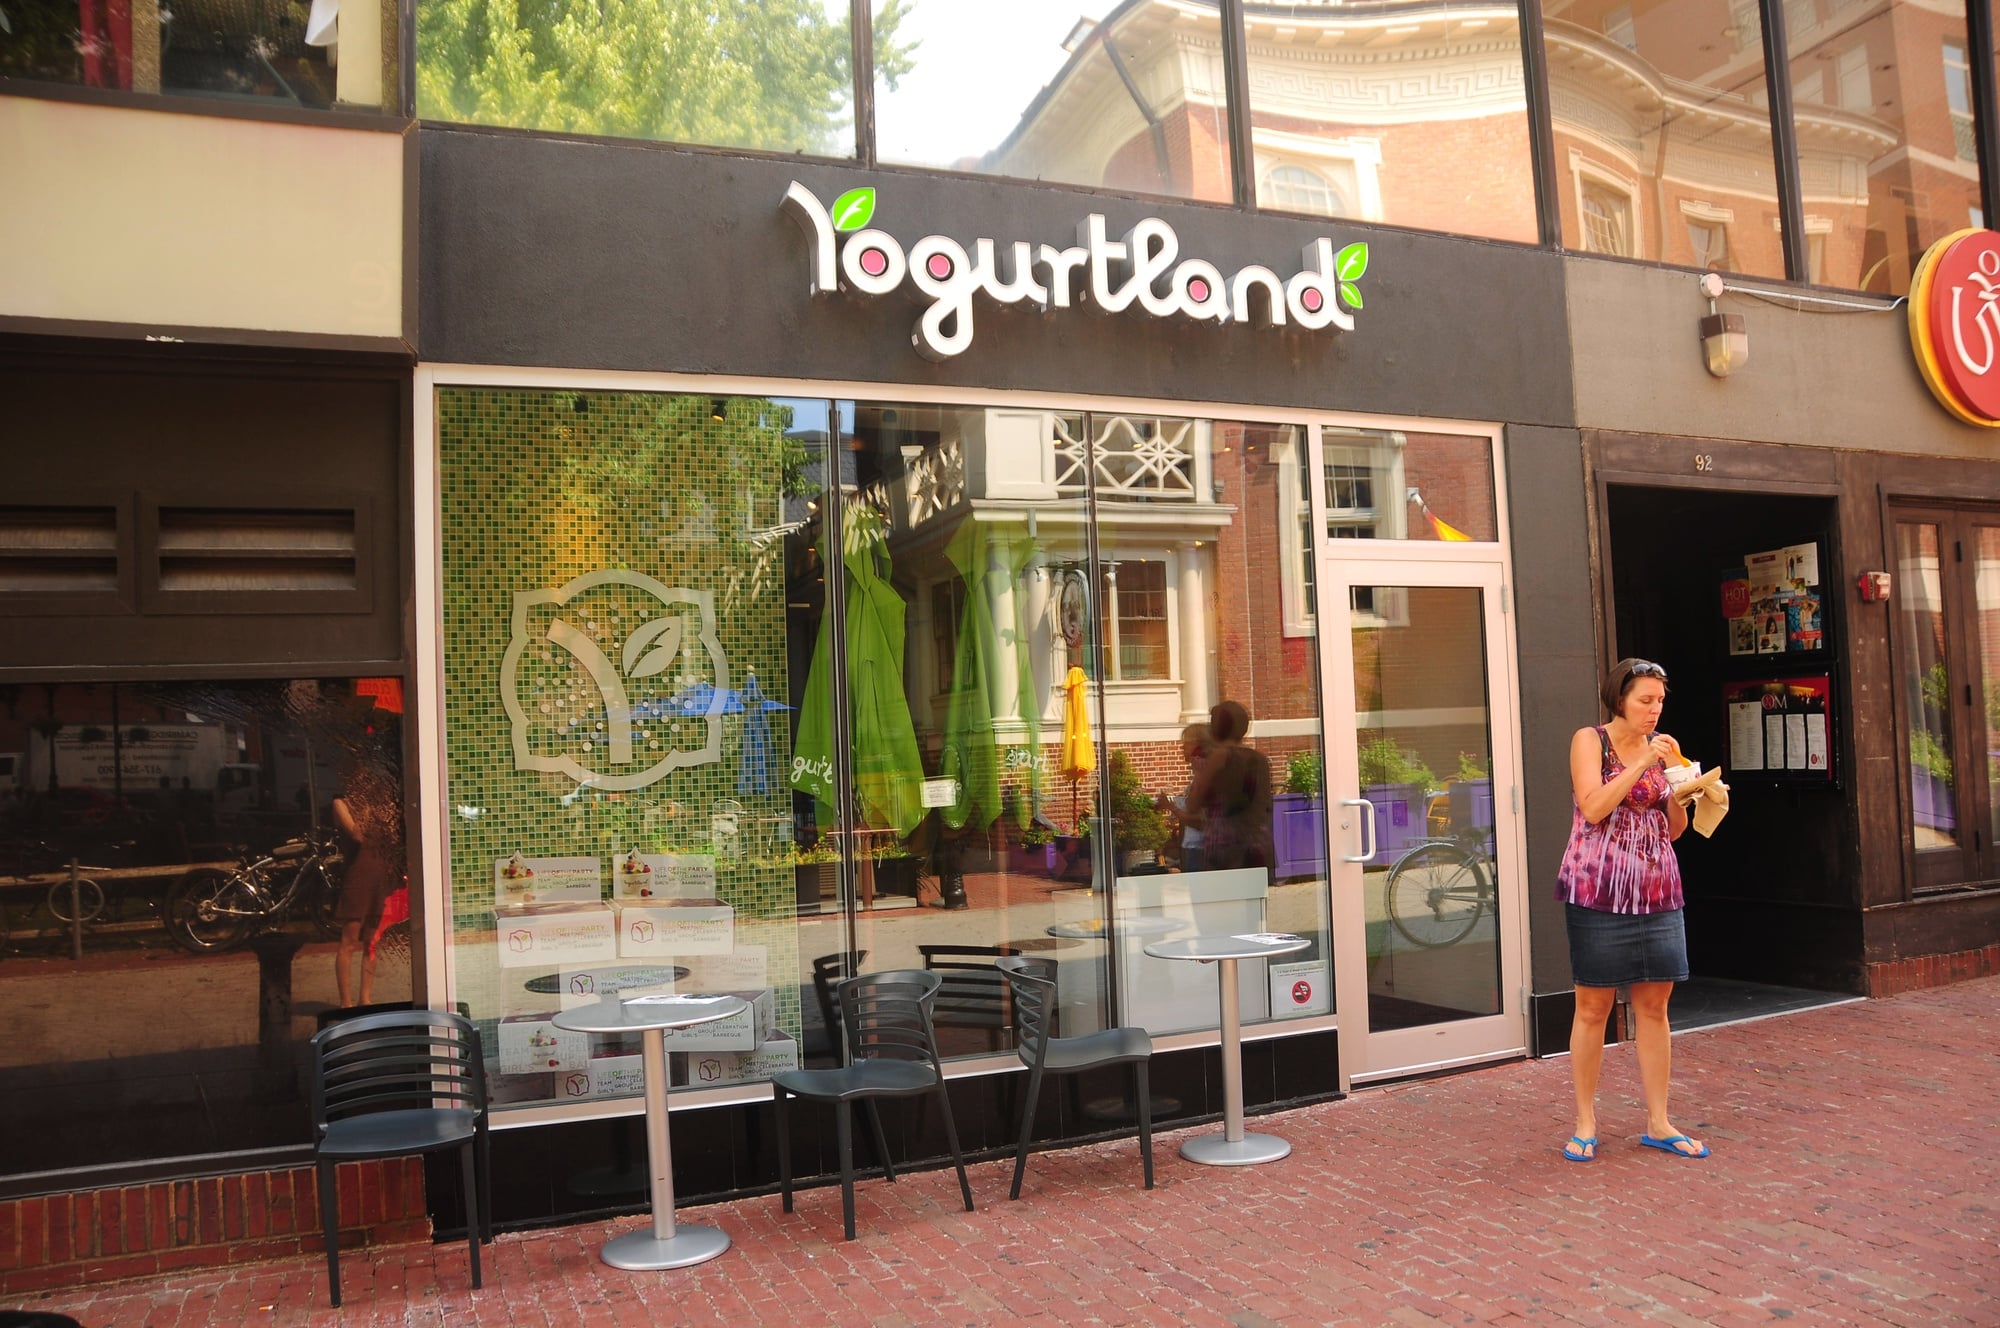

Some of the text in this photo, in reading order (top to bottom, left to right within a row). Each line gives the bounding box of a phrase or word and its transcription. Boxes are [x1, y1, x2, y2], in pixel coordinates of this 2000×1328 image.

[781, 180, 1357, 361] Yogurtland
[1695, 454, 1713, 471] 92
[1725, 586, 1746, 601] HOT
